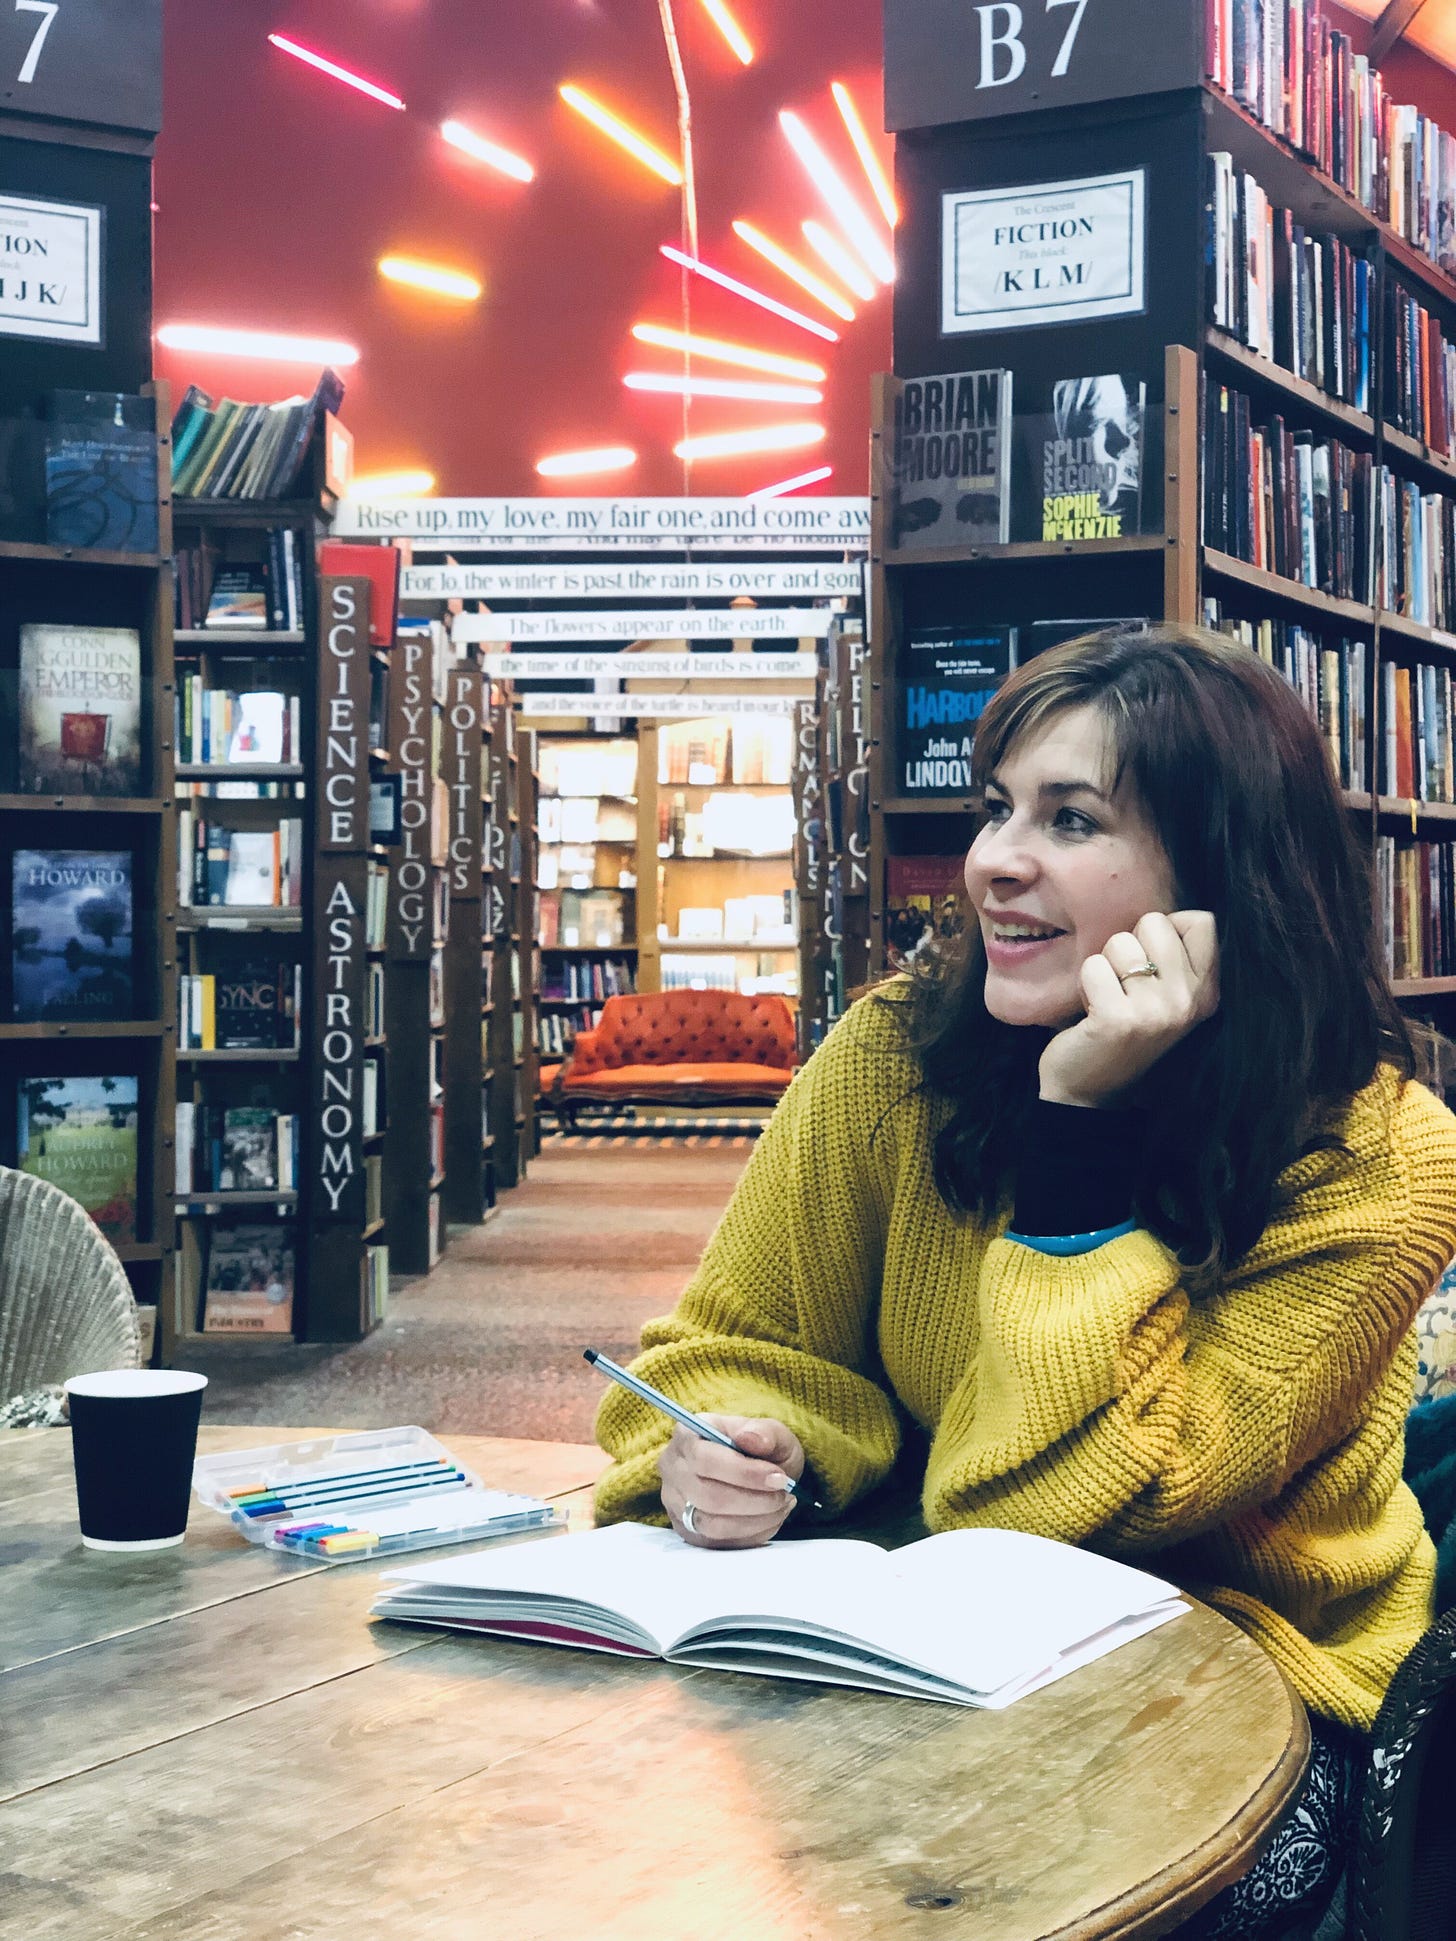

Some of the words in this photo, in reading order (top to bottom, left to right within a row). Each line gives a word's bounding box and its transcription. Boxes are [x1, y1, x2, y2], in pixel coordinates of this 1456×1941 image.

[15, 0, 59, 83] 7
[973, 3, 1026, 89] B
[1045, 0, 1089, 77] 7
[1, 234, 48, 257] ION
[994, 216, 1095, 246] FICTION
[904, 373, 998, 435] BRIAN
[901, 429, 996, 483] MOORE
[1044, 437, 1096, 467] SPLIT
[1044, 462, 1117, 494] SECOND
[357, 504, 408, 529] Rise
[457, 509, 494, 533] my
[567, 509, 602, 533] my
[611, 504, 651, 529] fair
[711, 503, 756, 529] and
[763, 509, 831, 529] come
[839, 509, 871, 528] aw
[1043, 493, 1100, 521] SOPHIE
[465, 570, 494, 591] the
[499, 571, 557, 591] winter
[564, 570, 580, 590] is
[628, 569, 657, 589] the
[660, 569, 699, 589] rain
[706, 569, 723, 589] is
[729, 572, 777, 588] over
[783, 568, 819, 589] and
[824, 572, 860, 591] gon
[510, 617, 539, 635] The
[545, 617, 607, 635] flowers
[612, 617, 675, 637] appear
[680, 619, 702, 633] on
[708, 615, 736, 632] the
[62, 636, 107, 649] CONN
[35, 668, 133, 690] EMPEROR
[501, 658, 523, 673] the
[527, 658, 559, 673] time
[565, 657, 580, 672] of
[584, 657, 609, 673] the
[675, 656, 690, 672] of
[694, 657, 735, 673] birds
[739, 658, 753, 672] is
[326, 585, 357, 843] SCIENCE
[923, 737, 958, 758] John
[960, 736, 976, 757] A
[451, 677, 476, 891] POLITICS
[905, 760, 972, 788] LINDQV
[399, 644, 427, 953] PSYCHOLOGY
[29, 868, 126, 887] HOWARD
[320, 880, 355, 1211] ASTRONOMY
[37, 1152, 128, 1173] HOWARD
